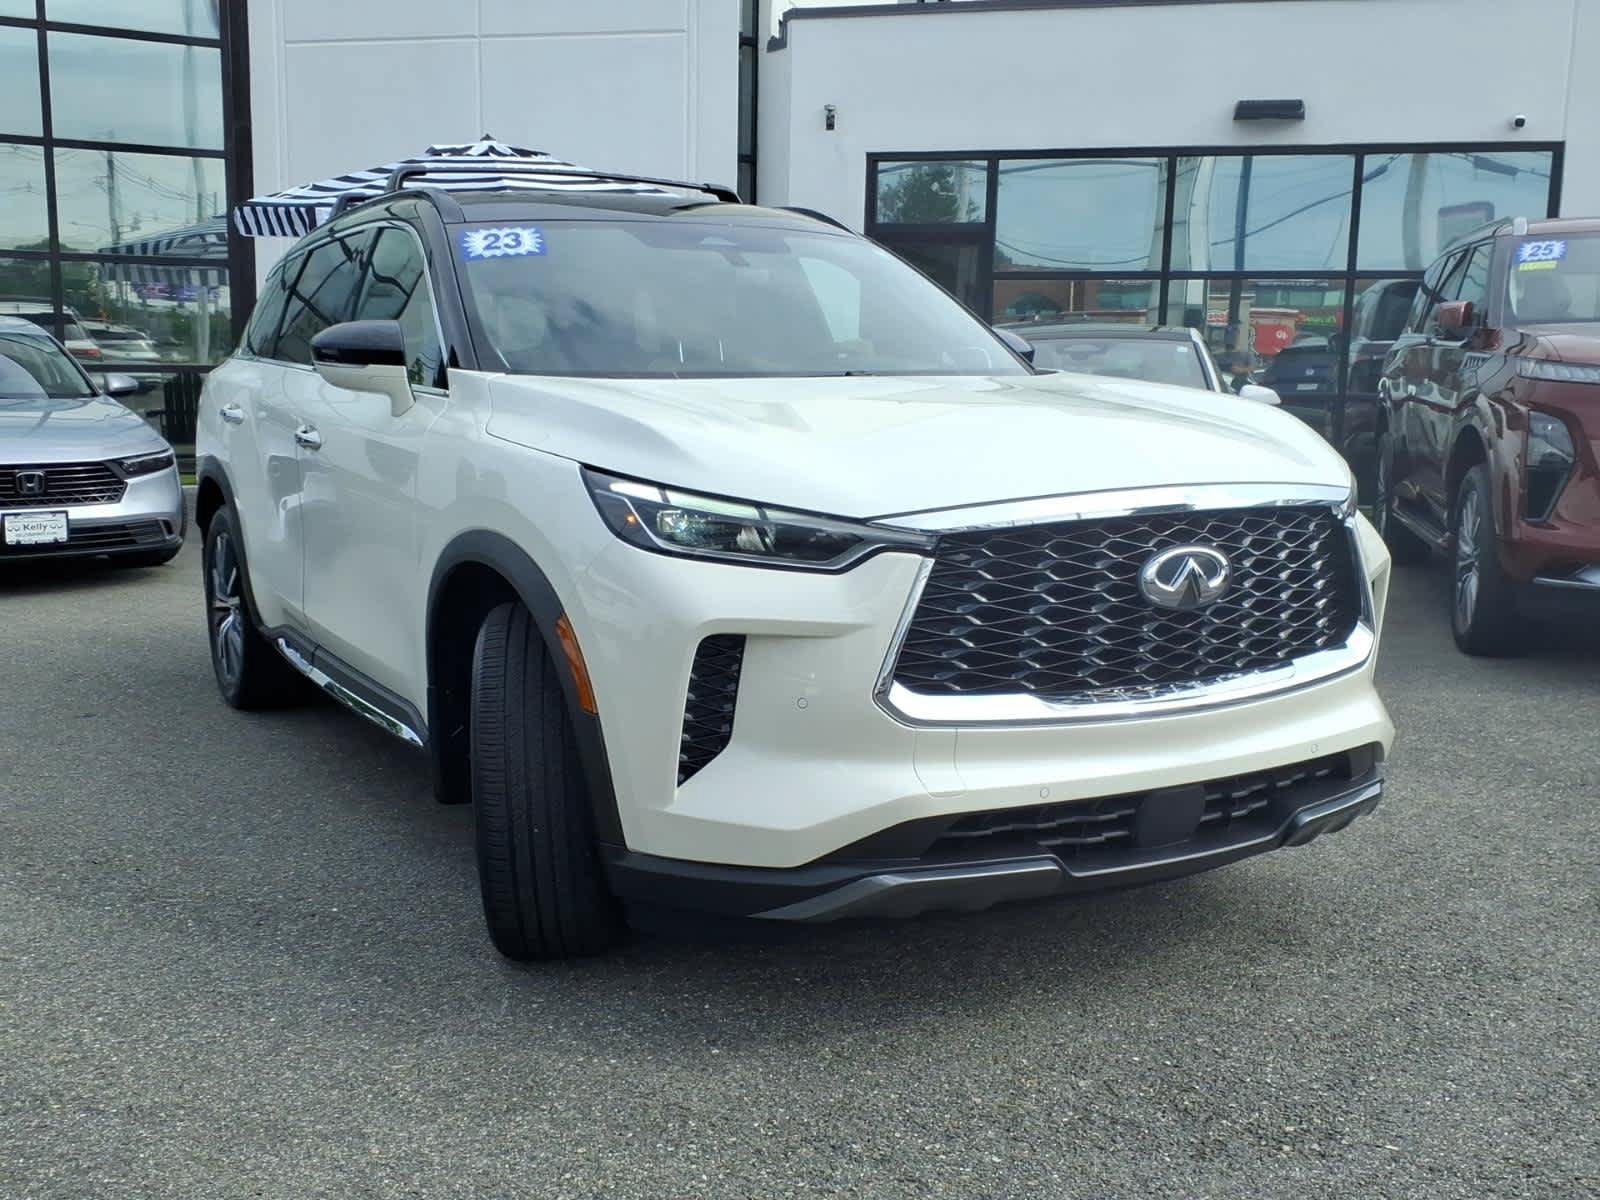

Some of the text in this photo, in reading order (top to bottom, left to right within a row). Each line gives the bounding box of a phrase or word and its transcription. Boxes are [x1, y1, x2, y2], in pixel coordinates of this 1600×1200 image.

[482, 232, 522, 251] 23
[1528, 244, 1553, 257] 25
[23, 523, 48, 533] Kelly
